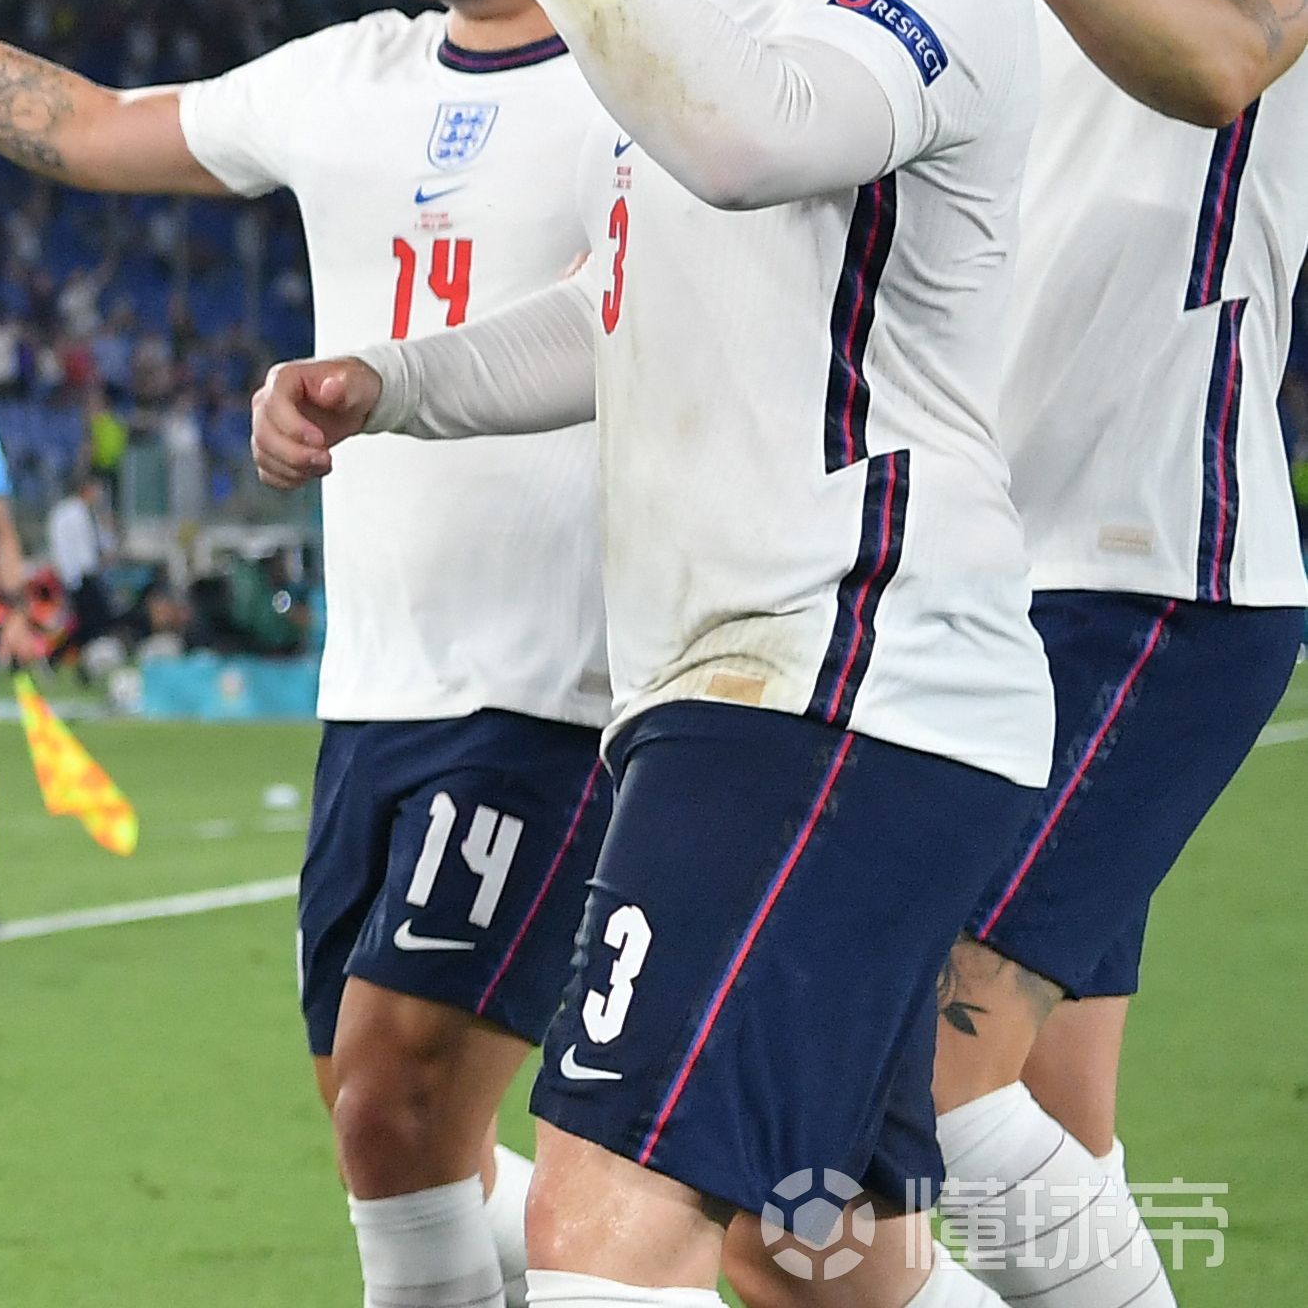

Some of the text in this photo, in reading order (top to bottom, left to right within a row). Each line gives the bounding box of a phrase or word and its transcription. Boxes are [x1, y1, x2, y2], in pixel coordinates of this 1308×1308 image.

[390, 236, 473, 340] 14
[601, 194, 629, 336] 3
[405, 790, 525, 930] 14
[582, 903, 653, 1045] 3
